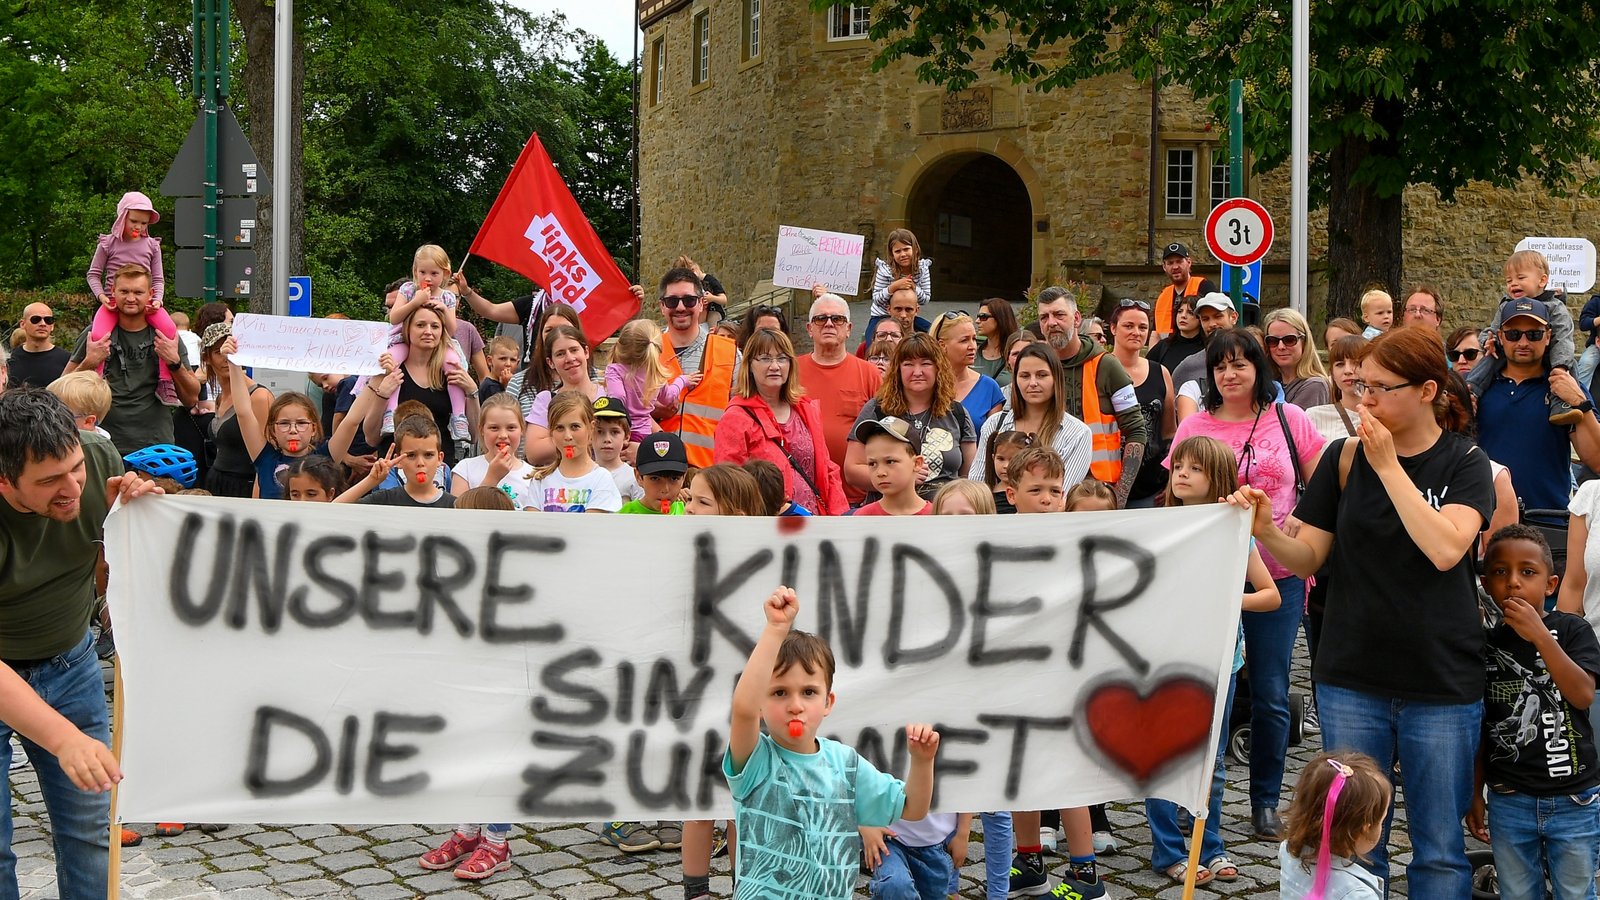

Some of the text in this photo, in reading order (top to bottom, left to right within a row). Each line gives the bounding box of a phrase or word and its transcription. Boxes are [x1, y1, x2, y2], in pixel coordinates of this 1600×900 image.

[540, 223, 587, 283] links
[1527, 241, 1584, 251] Leere Stadtkasse
[778, 256, 849, 280] kann MAMA
[1559, 267, 1581, 276] Kosten
[277, 320, 338, 336] brauchen
[169, 511, 567, 644] UNSERE
[531, 647, 738, 729] SIN
[243, 704, 1075, 818] DIE ZUKNFT
